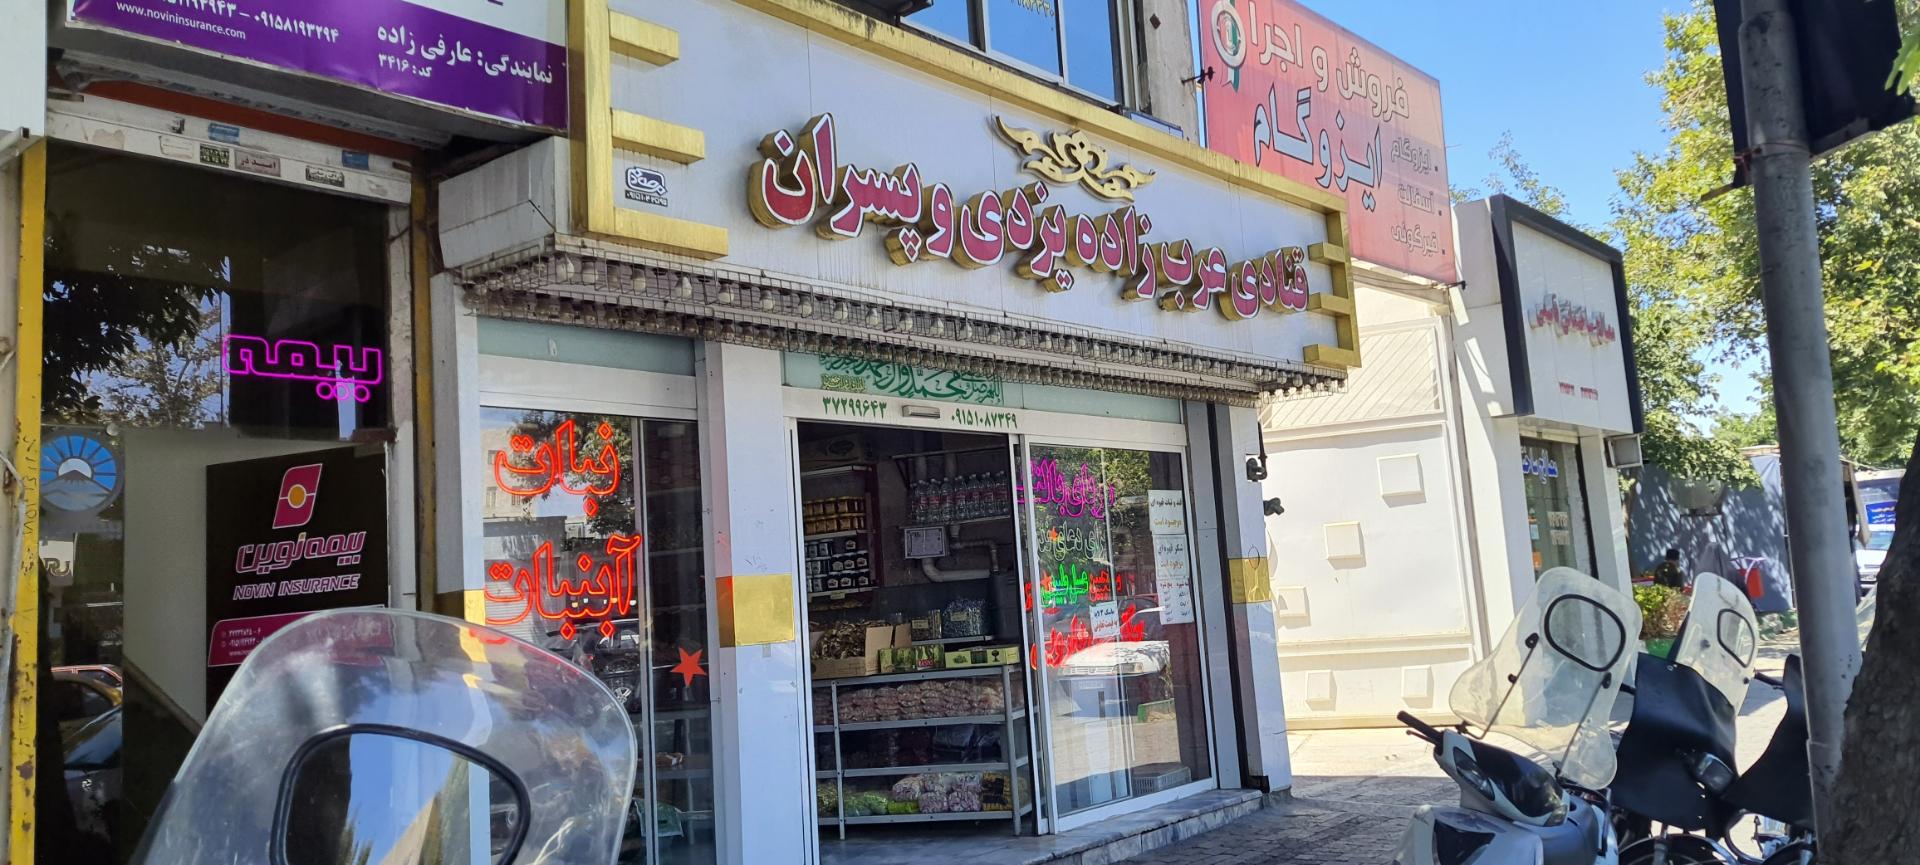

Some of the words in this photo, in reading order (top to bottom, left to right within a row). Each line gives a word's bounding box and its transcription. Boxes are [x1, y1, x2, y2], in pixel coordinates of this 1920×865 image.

[115, 1, 247, 40] www.novininsurance.com
[254, 10, 339, 43] ۰۹۱۵۸۱۹۳۲۹۴
[377, 25, 416, 56] زاده
[1249, 1, 1304, 73] اجرا
[378, 53, 410, 73] ۳۴۱۶
[412, 64, 433, 79] کد:
[420, 34, 472, 66] عارفی
[477, 51, 553, 85] نمایندگی:
[1311, 45, 1329, 92] و
[1336, 47, 1409, 122] فروش
[1253, 82, 1384, 213] ایزوگام
[1391, 137, 1432, 175] ایزوگام
[761, 112, 923, 263] پسران
[1398, 184, 1435, 214] آسفالت
[926, 182, 955, 259] و
[960, 180, 1075, 291] یزدی
[1391, 221, 1439, 257] قیرگونی
[1075, 205, 1158, 299] زاده
[1160, 239, 1228, 311] عرب
[1230, 246, 1310, 320] قنادی
[223, 334, 382, 402] بیمه
[822, 396, 888, 419] ۳۷۲۹۹۶۴۳
[951, 407, 1018, 430] ۰۹۱۵۱۰۸۷۳۴۹
[494, 418, 620, 518] نبات
[236, 532, 306, 575] نوین
[305, 531, 366, 566] بیمه
[233, 582, 277, 601] NOVIN
[277, 573, 361, 597] INSURANCE
[484, 533, 642, 641] آبنبات
